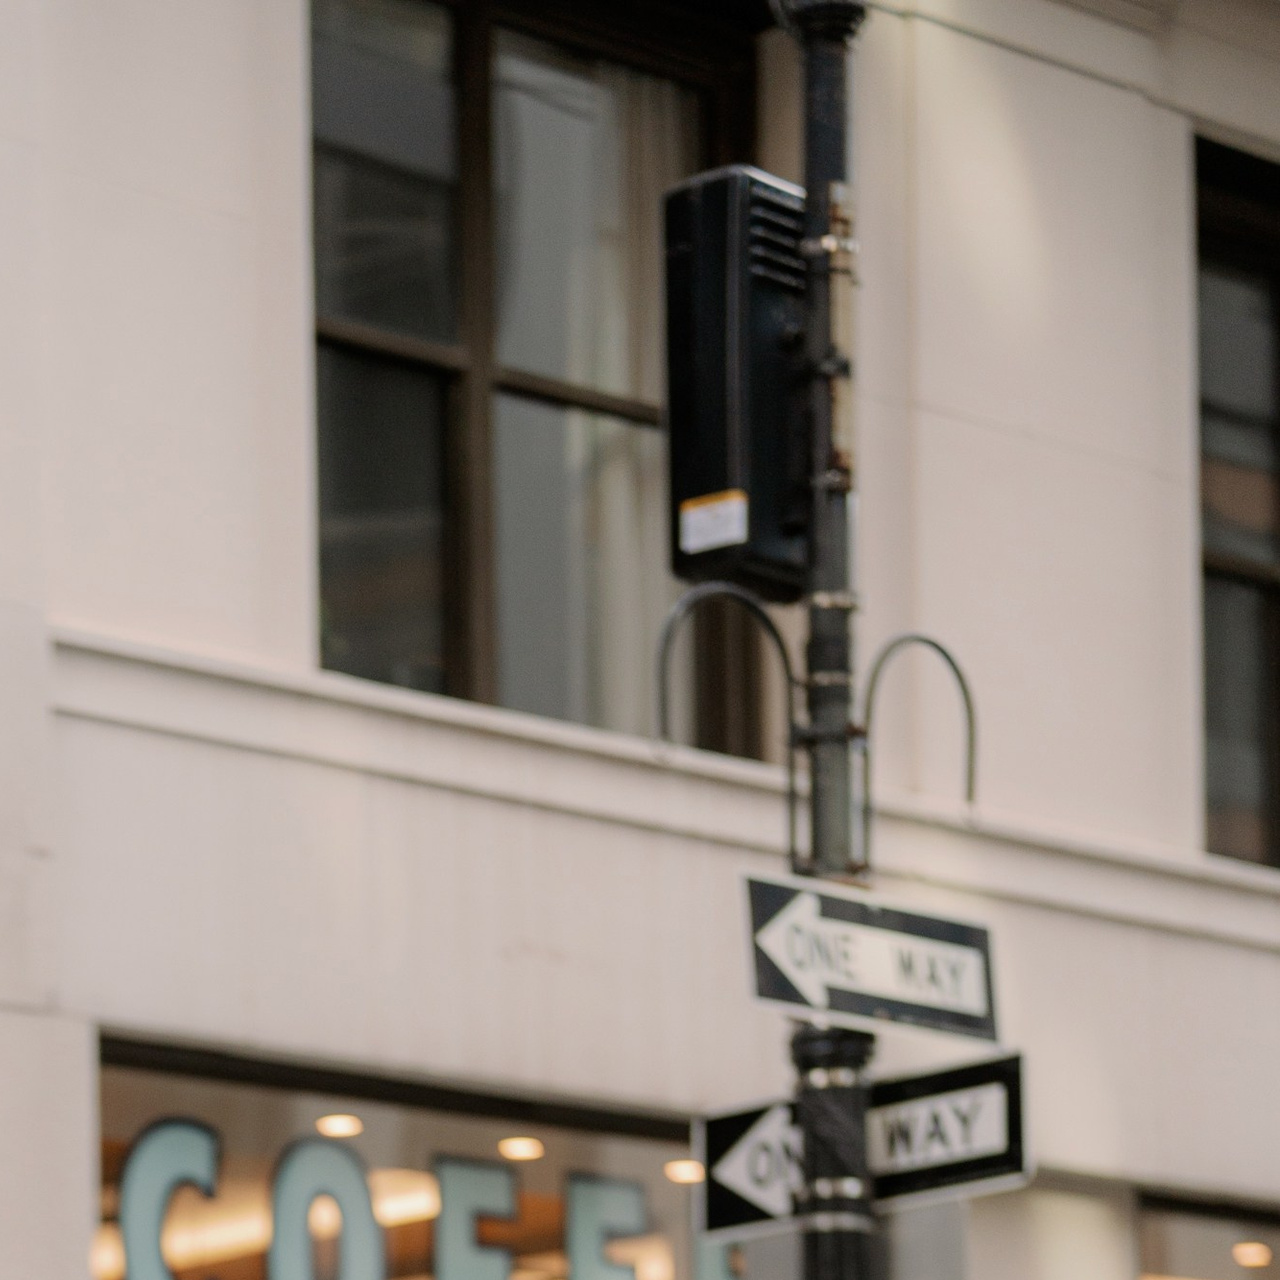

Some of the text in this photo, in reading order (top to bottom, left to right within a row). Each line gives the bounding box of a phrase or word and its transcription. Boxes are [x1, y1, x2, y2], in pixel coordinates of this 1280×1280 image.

[785, 922, 968, 1000] ONE WAY
[884, 1099, 982, 1159] WAY
